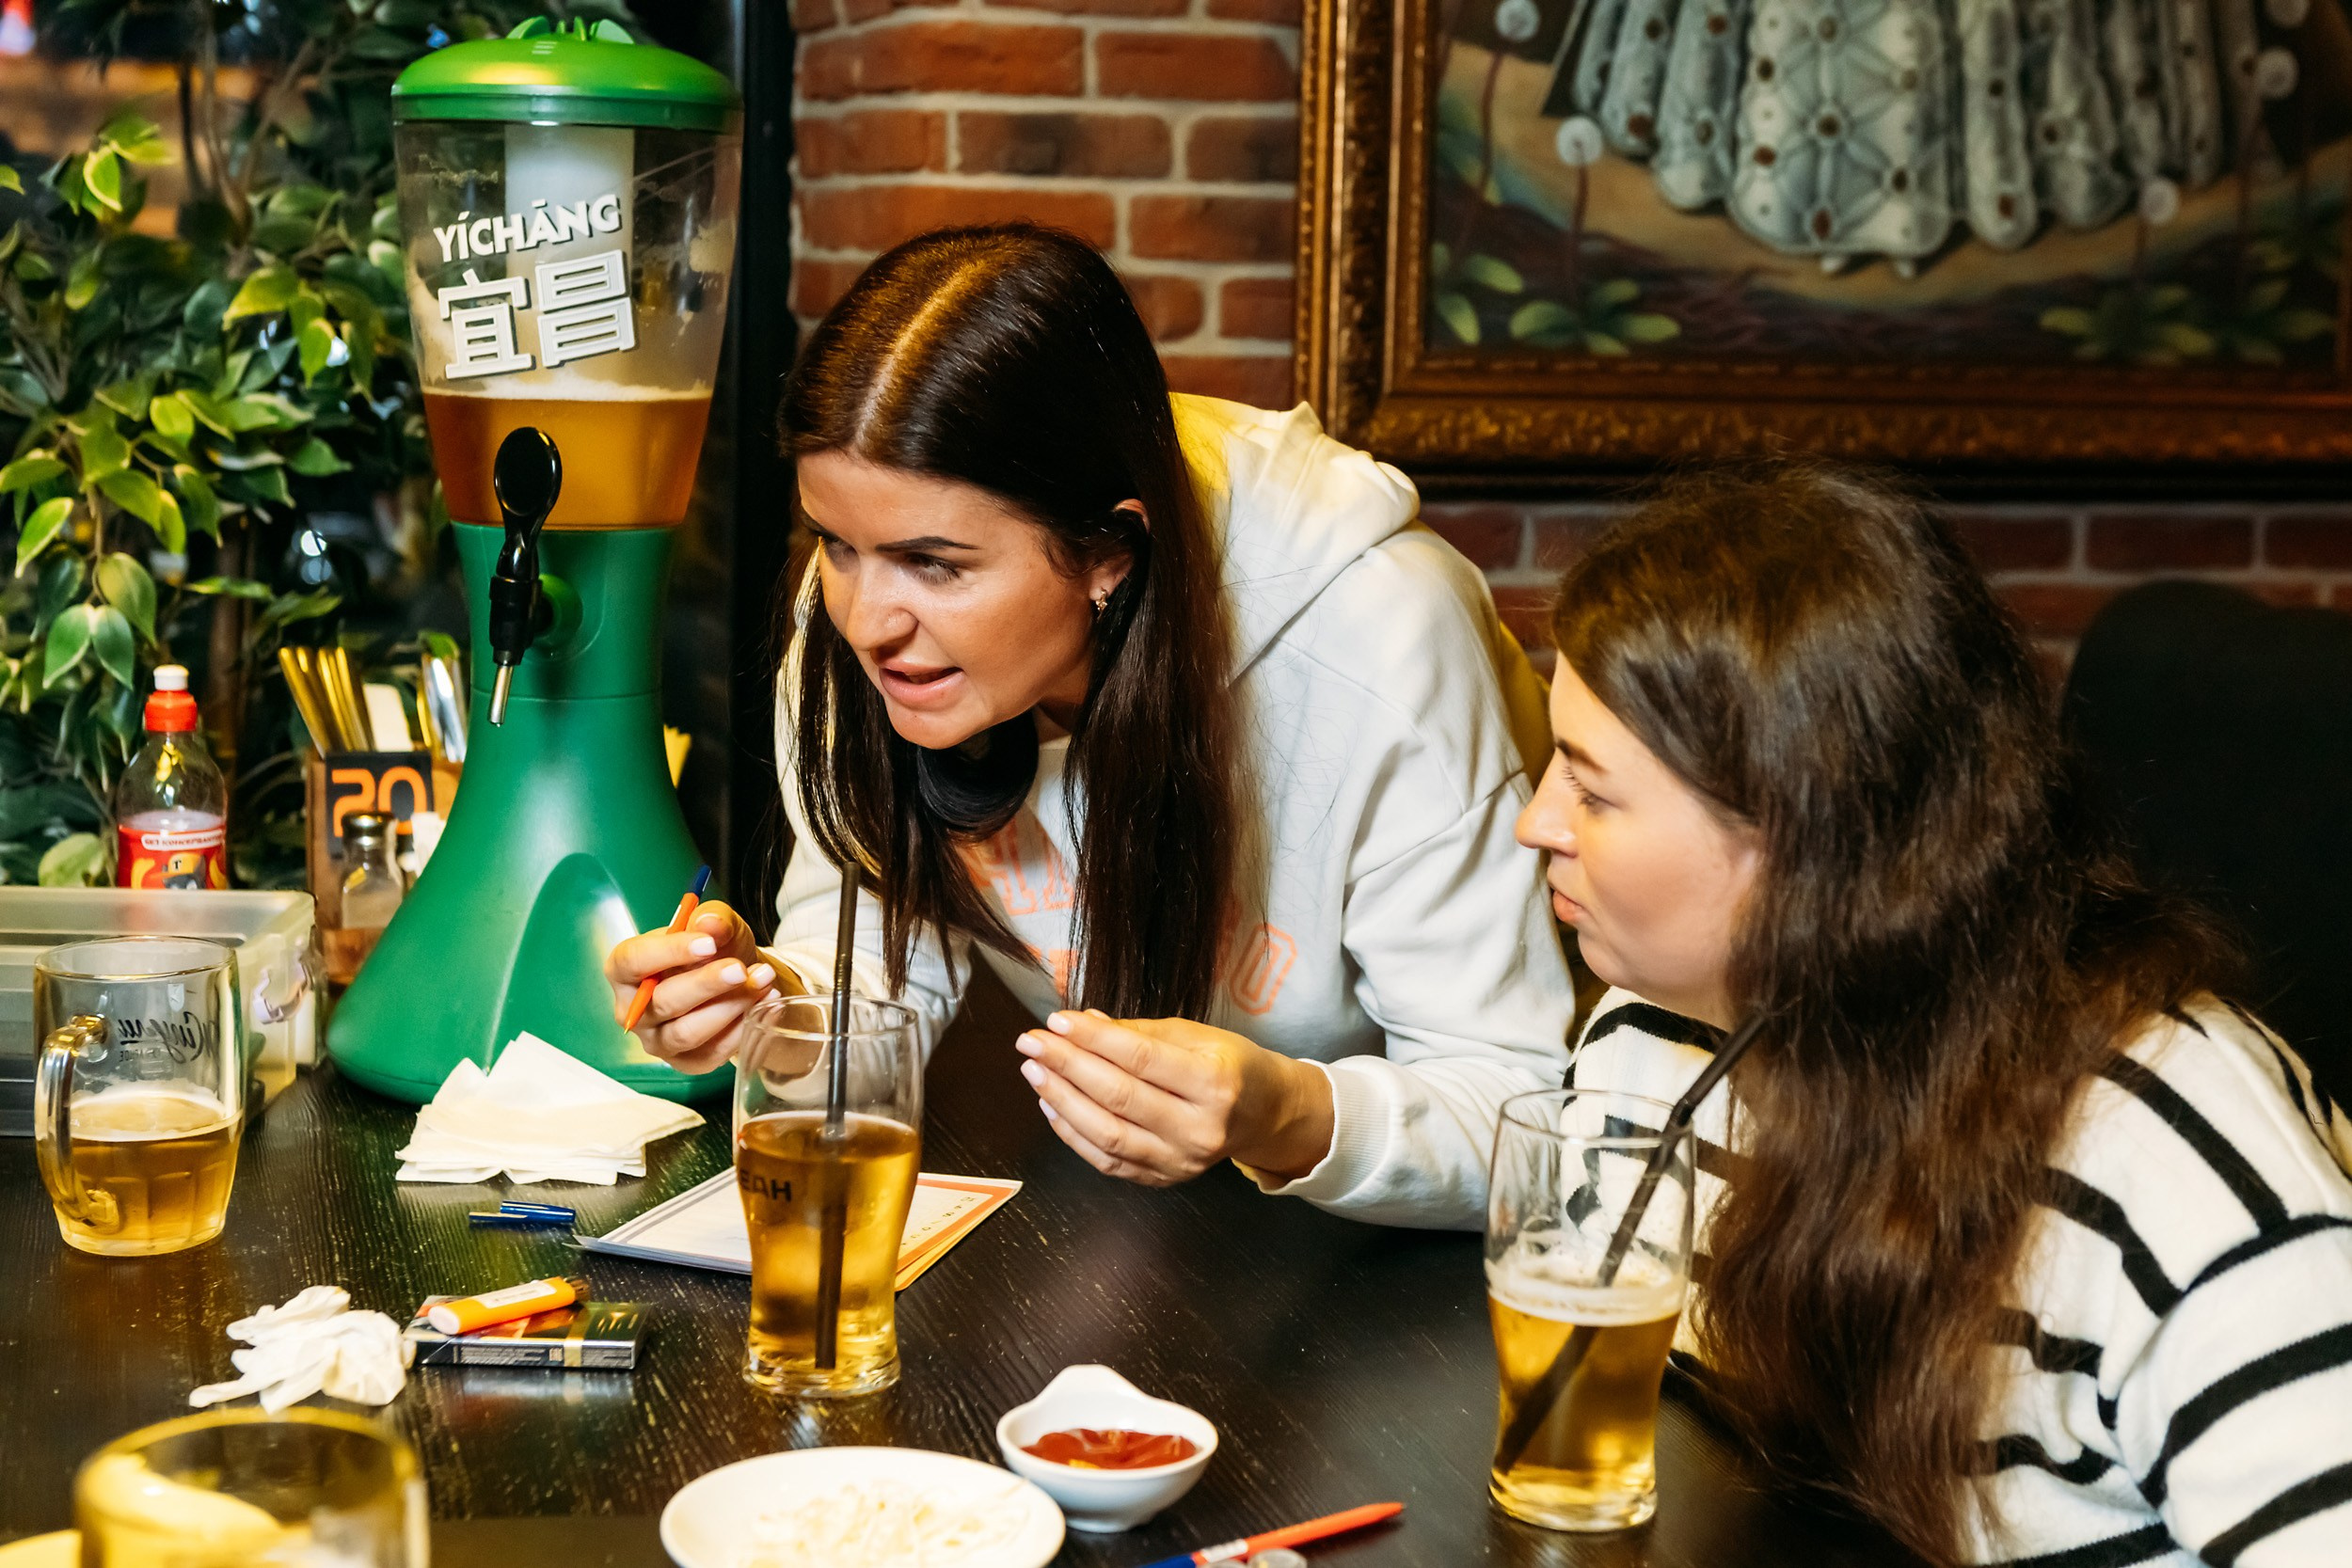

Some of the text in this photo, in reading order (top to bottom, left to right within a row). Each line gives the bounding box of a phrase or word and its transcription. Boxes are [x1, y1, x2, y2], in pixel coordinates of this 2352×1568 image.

[433, 194, 622, 262] YÍCHĀNG
[437, 249, 637, 380] 宜昌
[332, 766, 428, 837] 20
